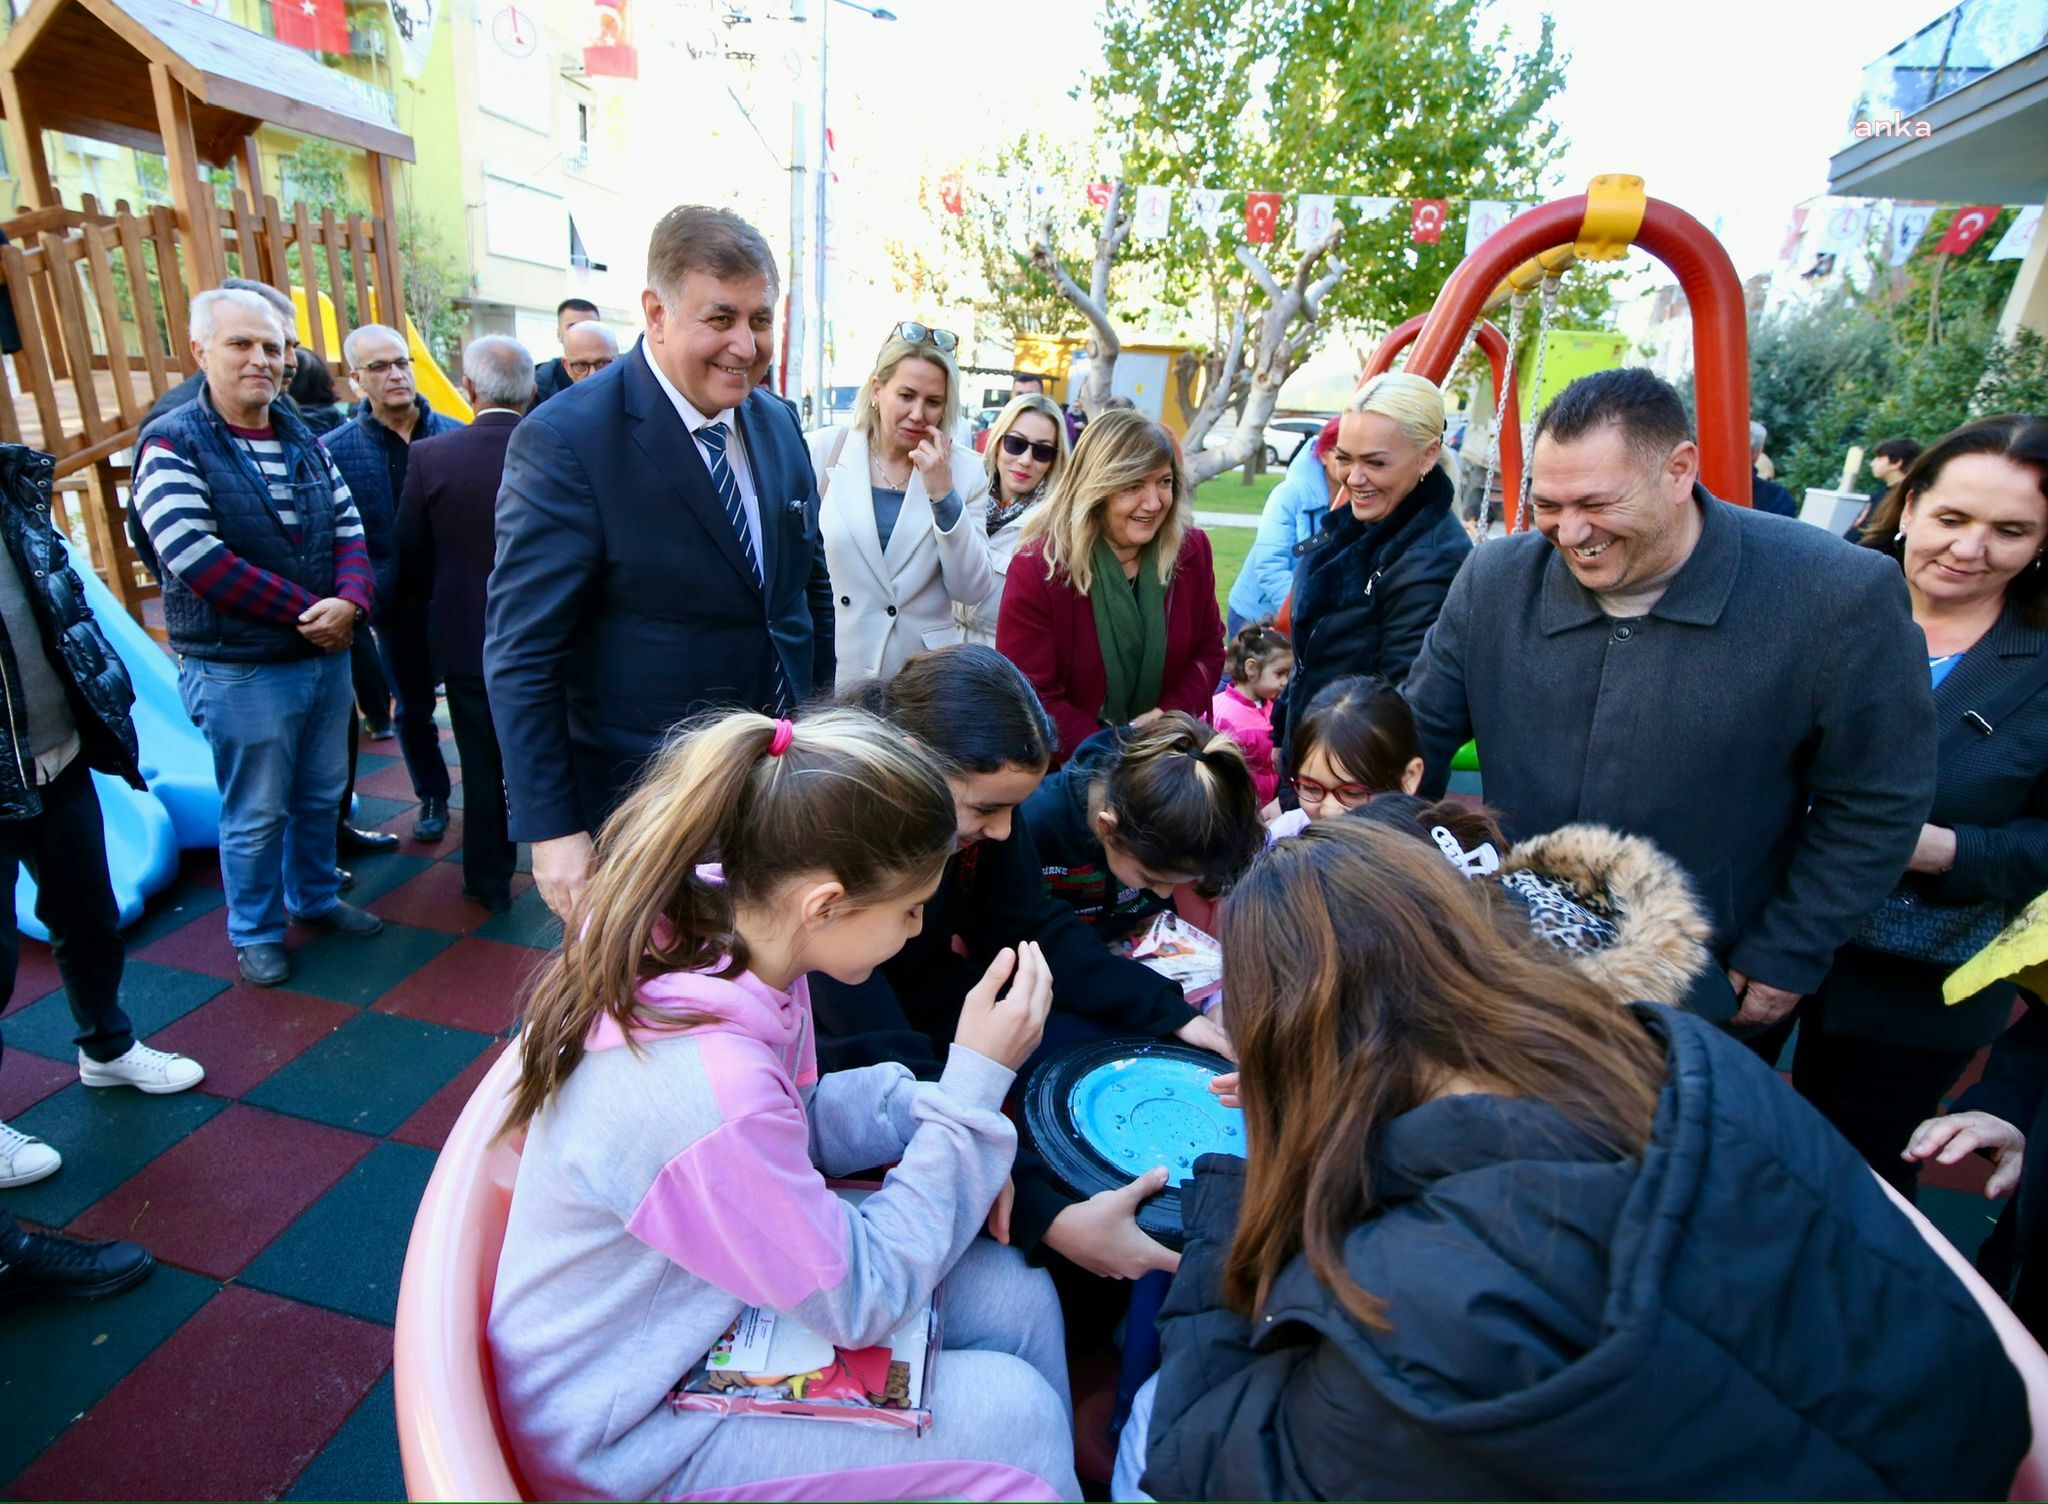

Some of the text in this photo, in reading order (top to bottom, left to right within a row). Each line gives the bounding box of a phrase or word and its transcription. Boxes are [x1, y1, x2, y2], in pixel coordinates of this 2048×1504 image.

[1869, 907, 1908, 923] ORS
[1969, 926, 1999, 938] TIM
[1871, 917, 1908, 935] TIME
[1932, 908, 1976, 926] COLO
[1857, 926, 1888, 942] ORS
